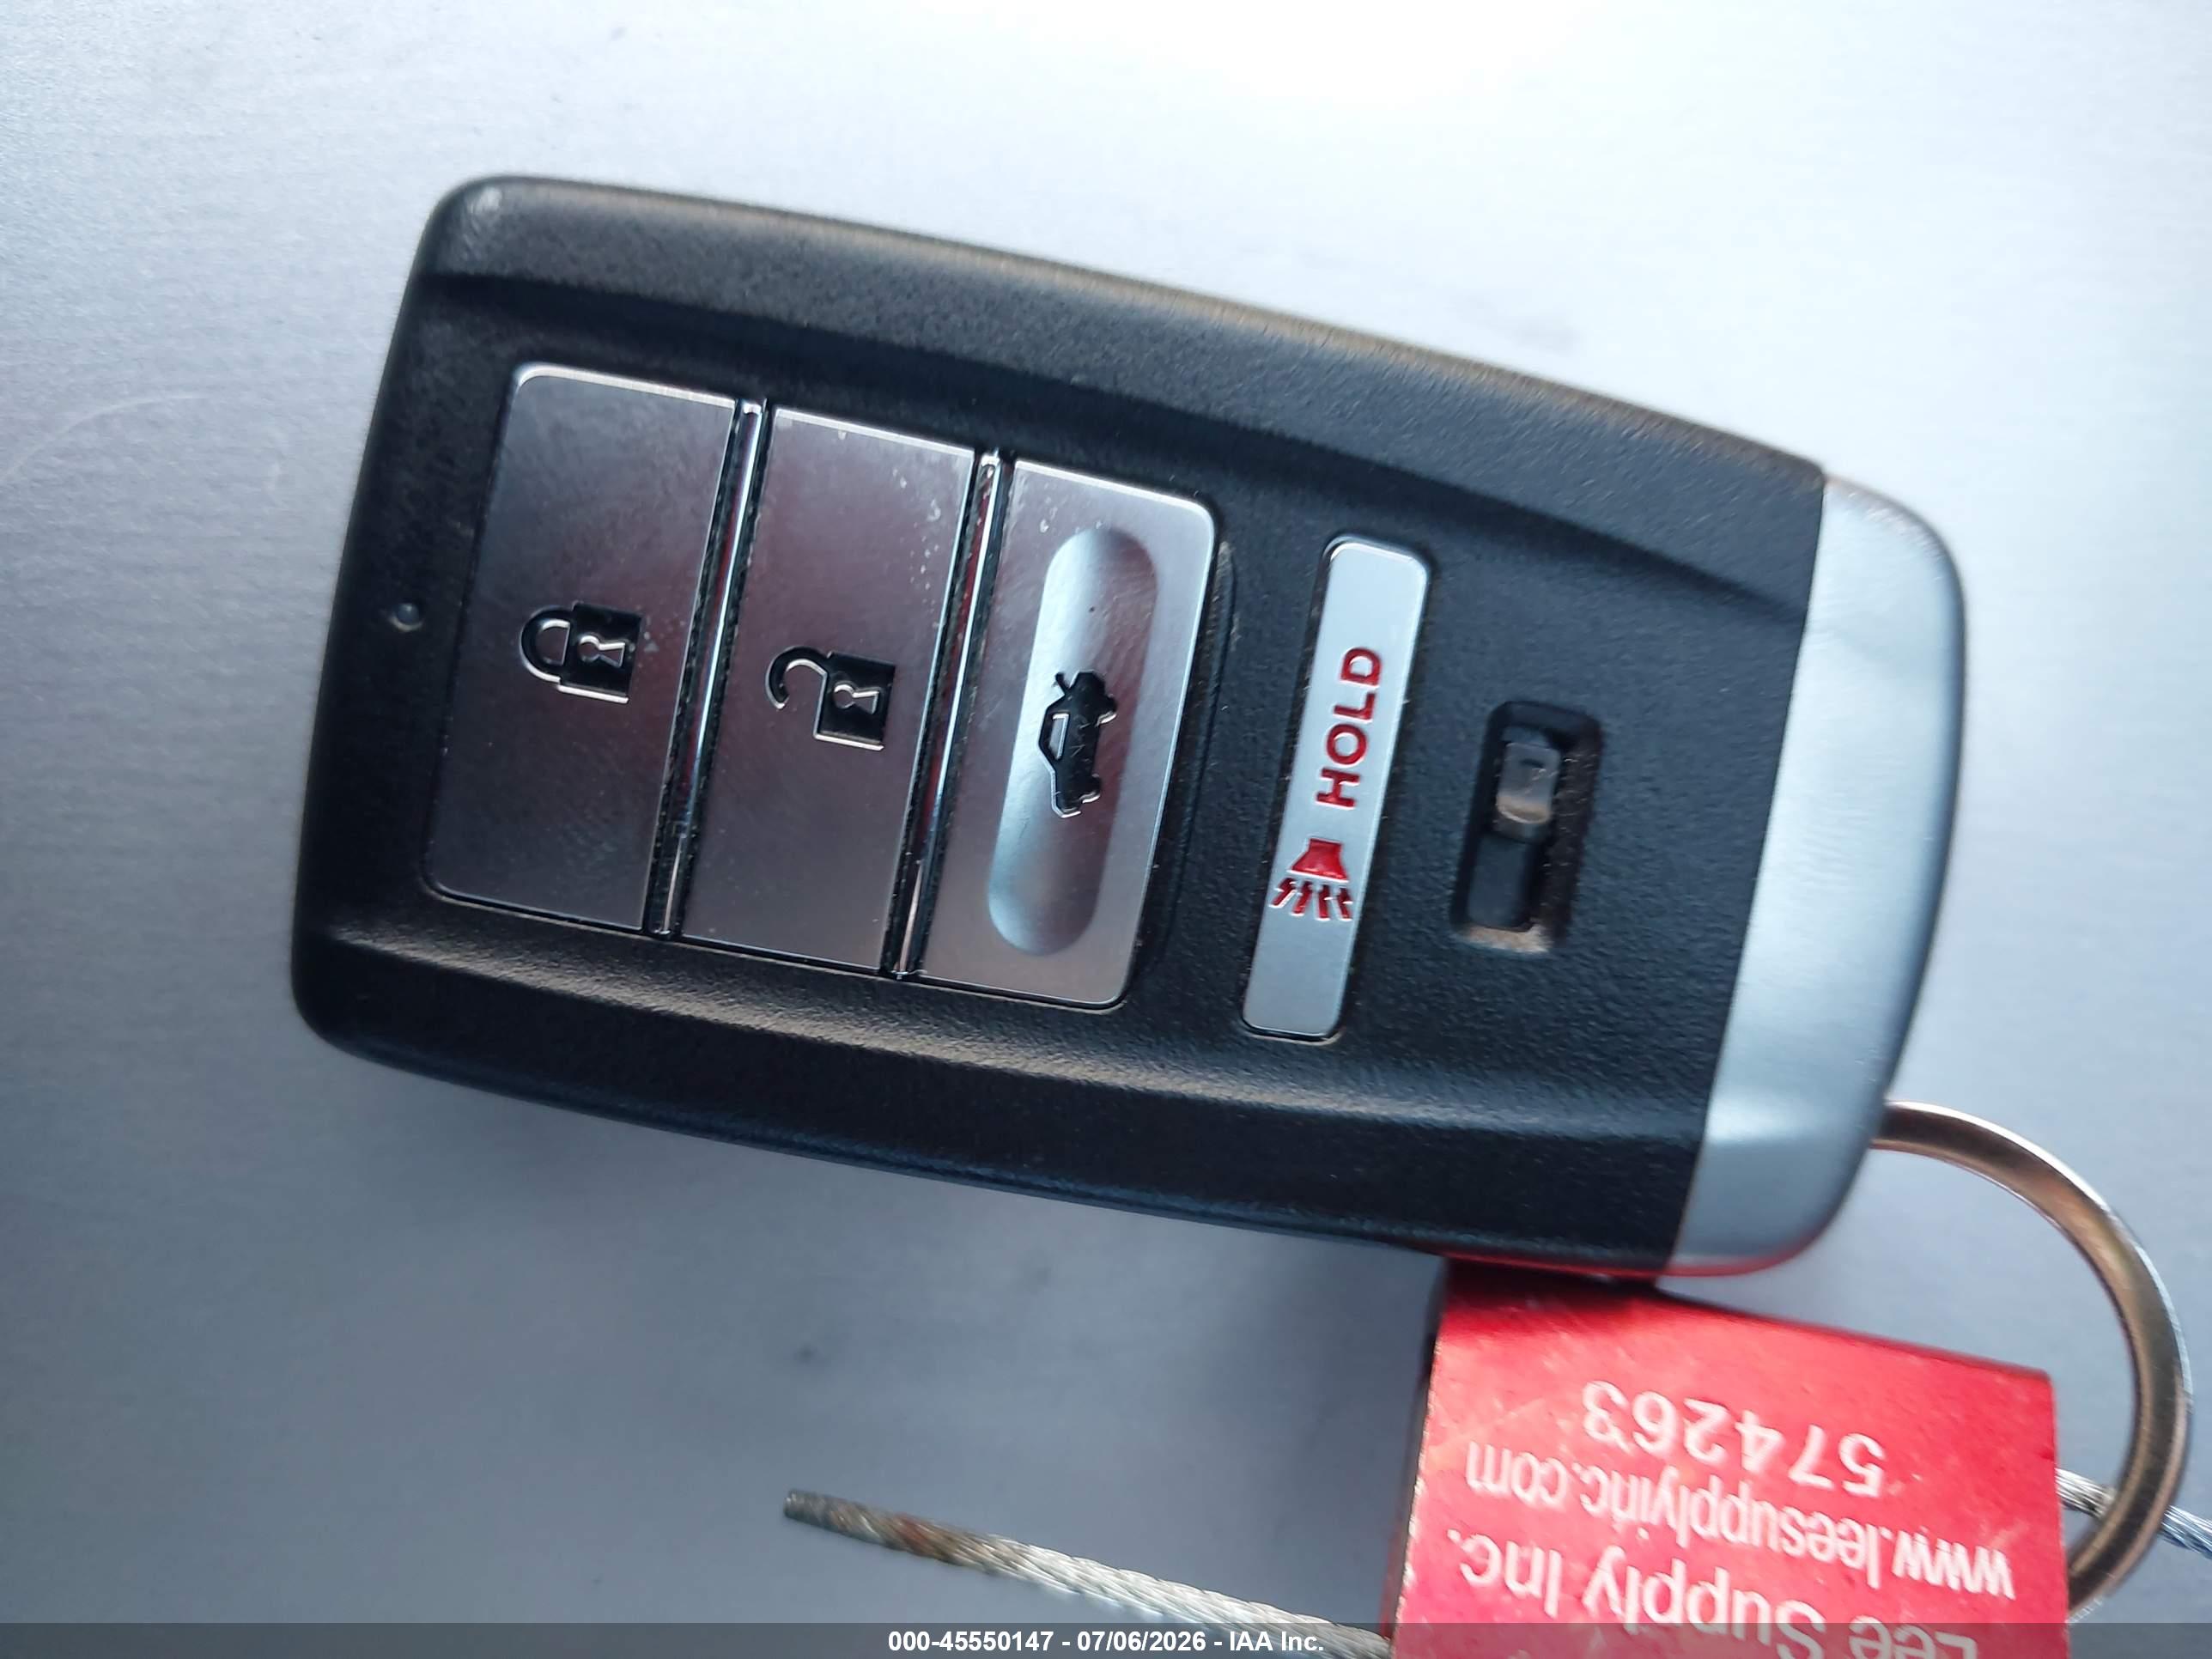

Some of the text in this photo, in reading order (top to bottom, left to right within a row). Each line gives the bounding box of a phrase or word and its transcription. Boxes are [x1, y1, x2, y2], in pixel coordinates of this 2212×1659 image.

[1316, 647, 1382, 808] HOLD
[1581, 1379, 1887, 1498] 574263
[1446, 1528, 1564, 1618] Inc.
[1465, 1441, 2016, 1601] www.leesupplyinc.com
[1581, 1544, 1828, 1659] Supply
